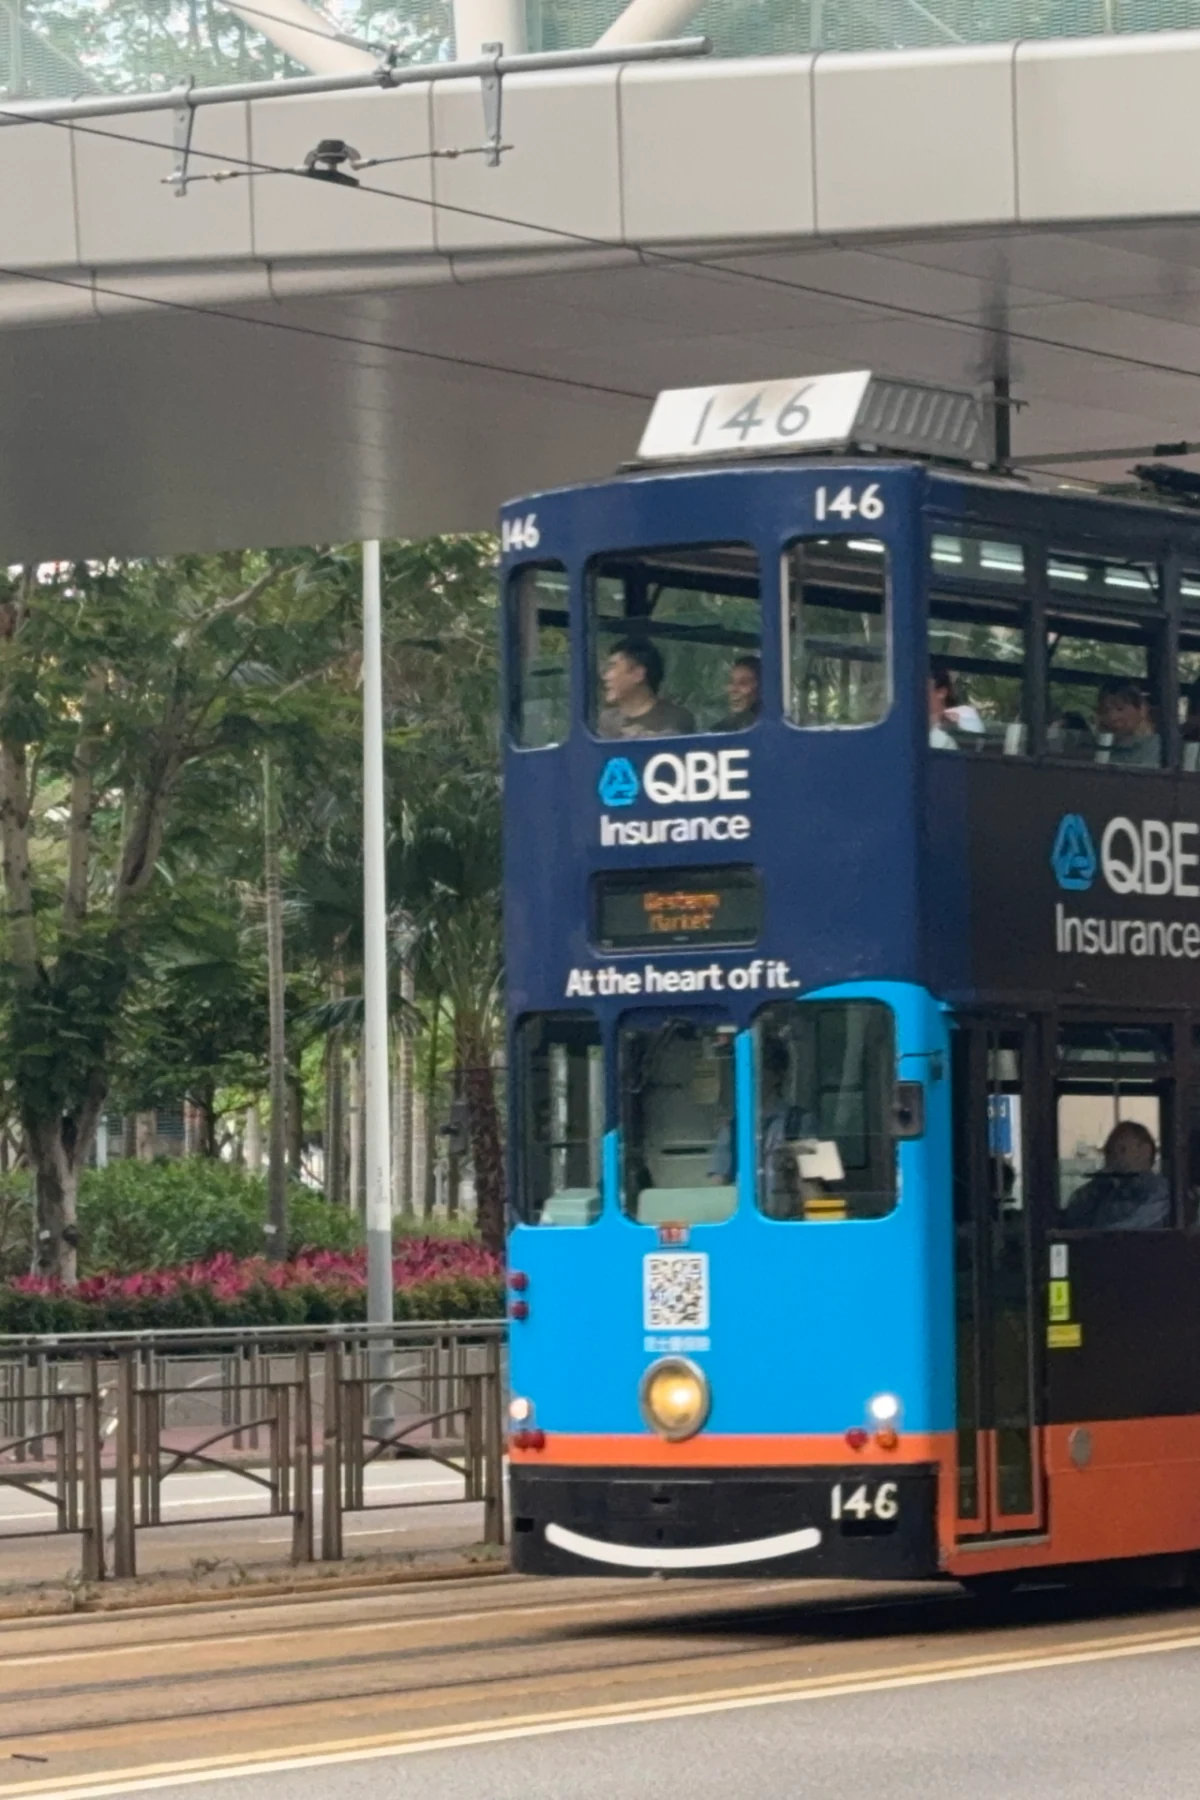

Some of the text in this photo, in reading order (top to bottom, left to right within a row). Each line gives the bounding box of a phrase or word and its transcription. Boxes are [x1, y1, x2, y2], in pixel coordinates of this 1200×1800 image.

[692, 384, 816, 447] 146
[814, 484, 884, 521] 146
[502, 513, 540, 552] 146
[644, 750, 750, 803] QBE
[600, 815, 750, 846] Insurance
[565, 960, 800, 997] At the heart of it.
[831, 1483, 898, 1519] 146
